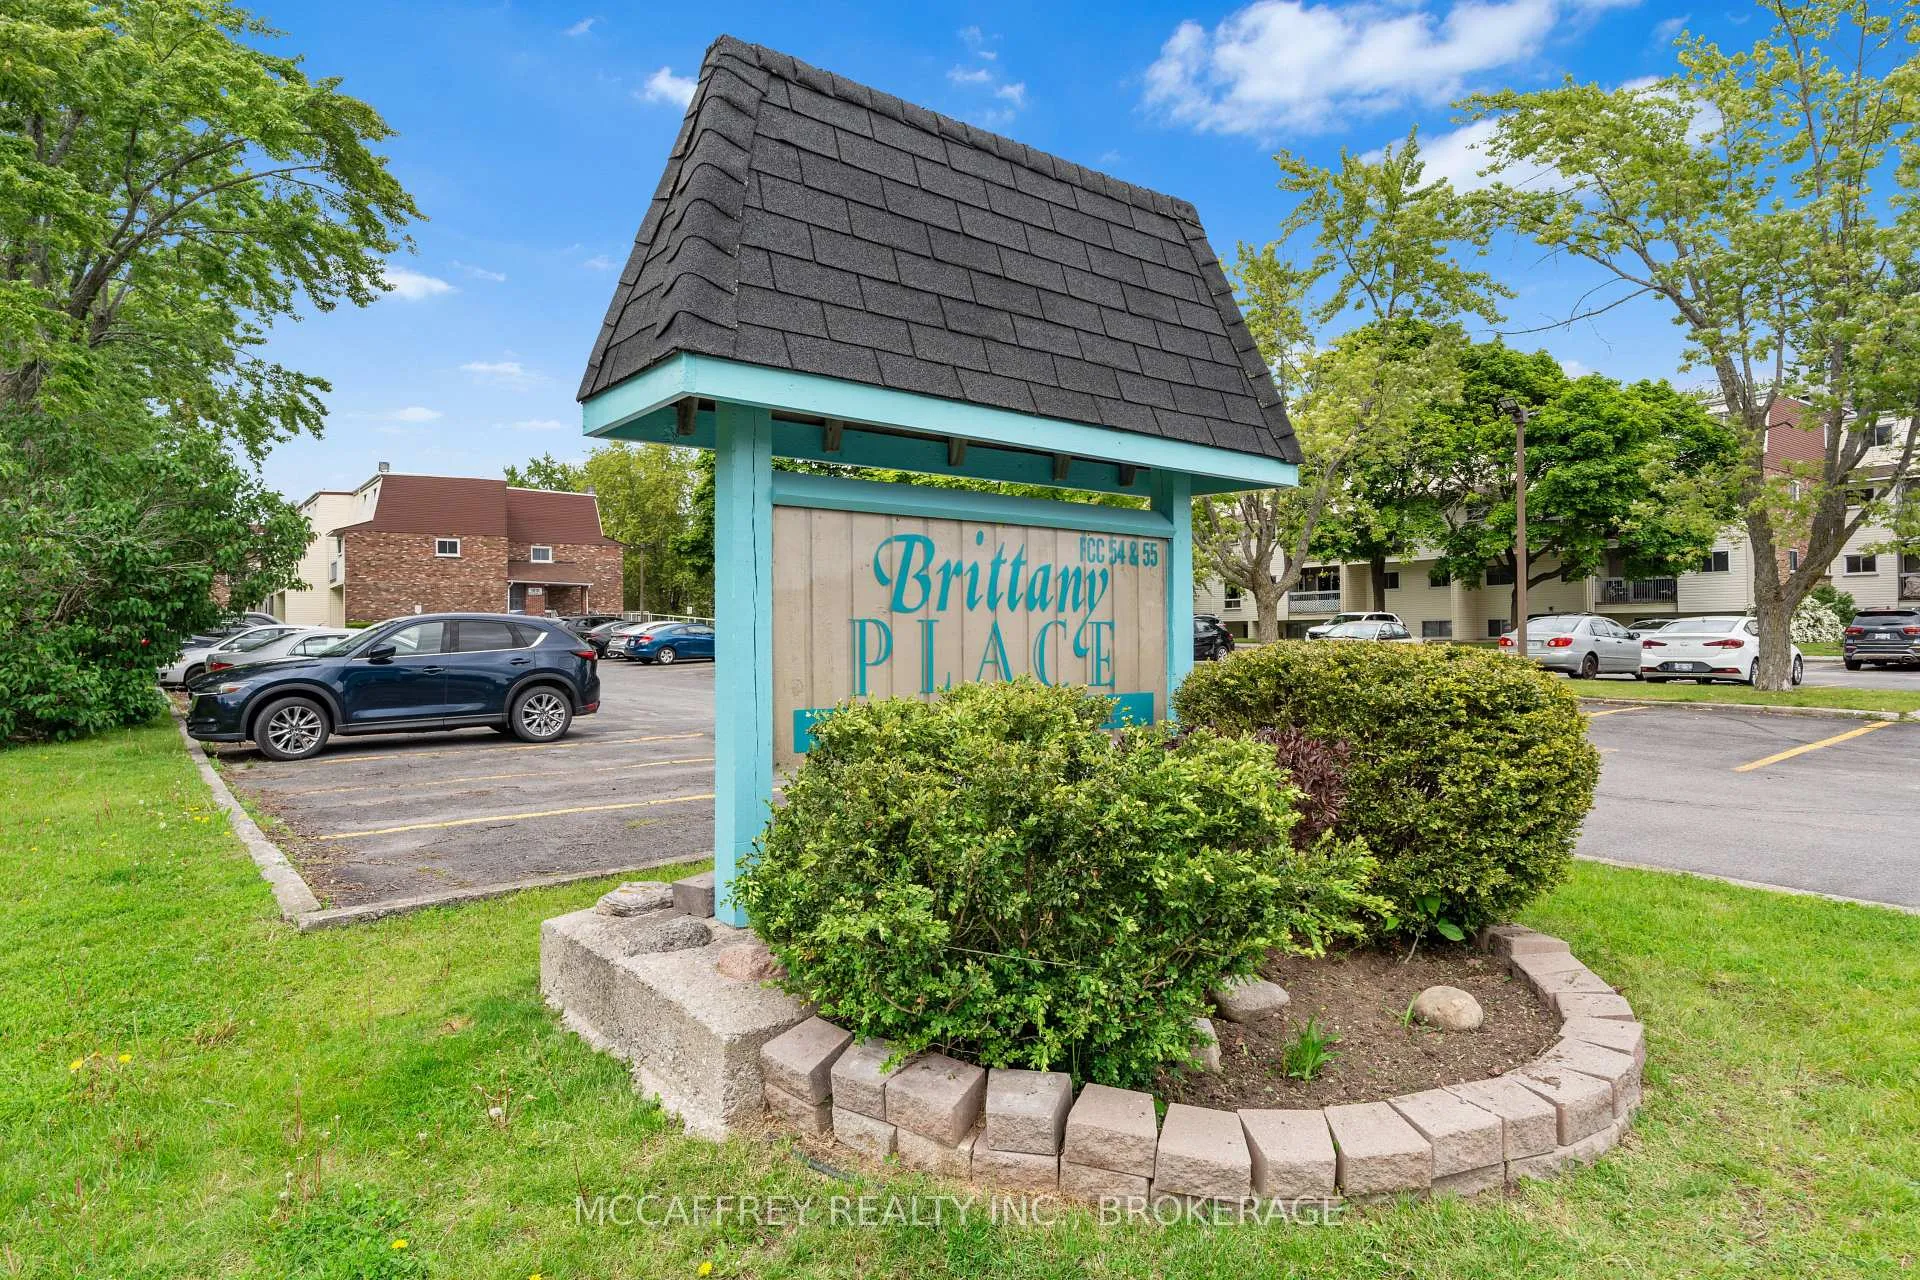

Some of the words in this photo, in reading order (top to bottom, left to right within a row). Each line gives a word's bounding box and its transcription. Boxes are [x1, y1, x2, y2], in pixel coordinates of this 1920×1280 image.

[1109, 538, 1126, 565] 54
[1129, 540, 1139, 566] &
[1143, 542, 1158, 567] 55
[873, 530, 1109, 658] Brittany
[848, 618, 1116, 697] PLACE
